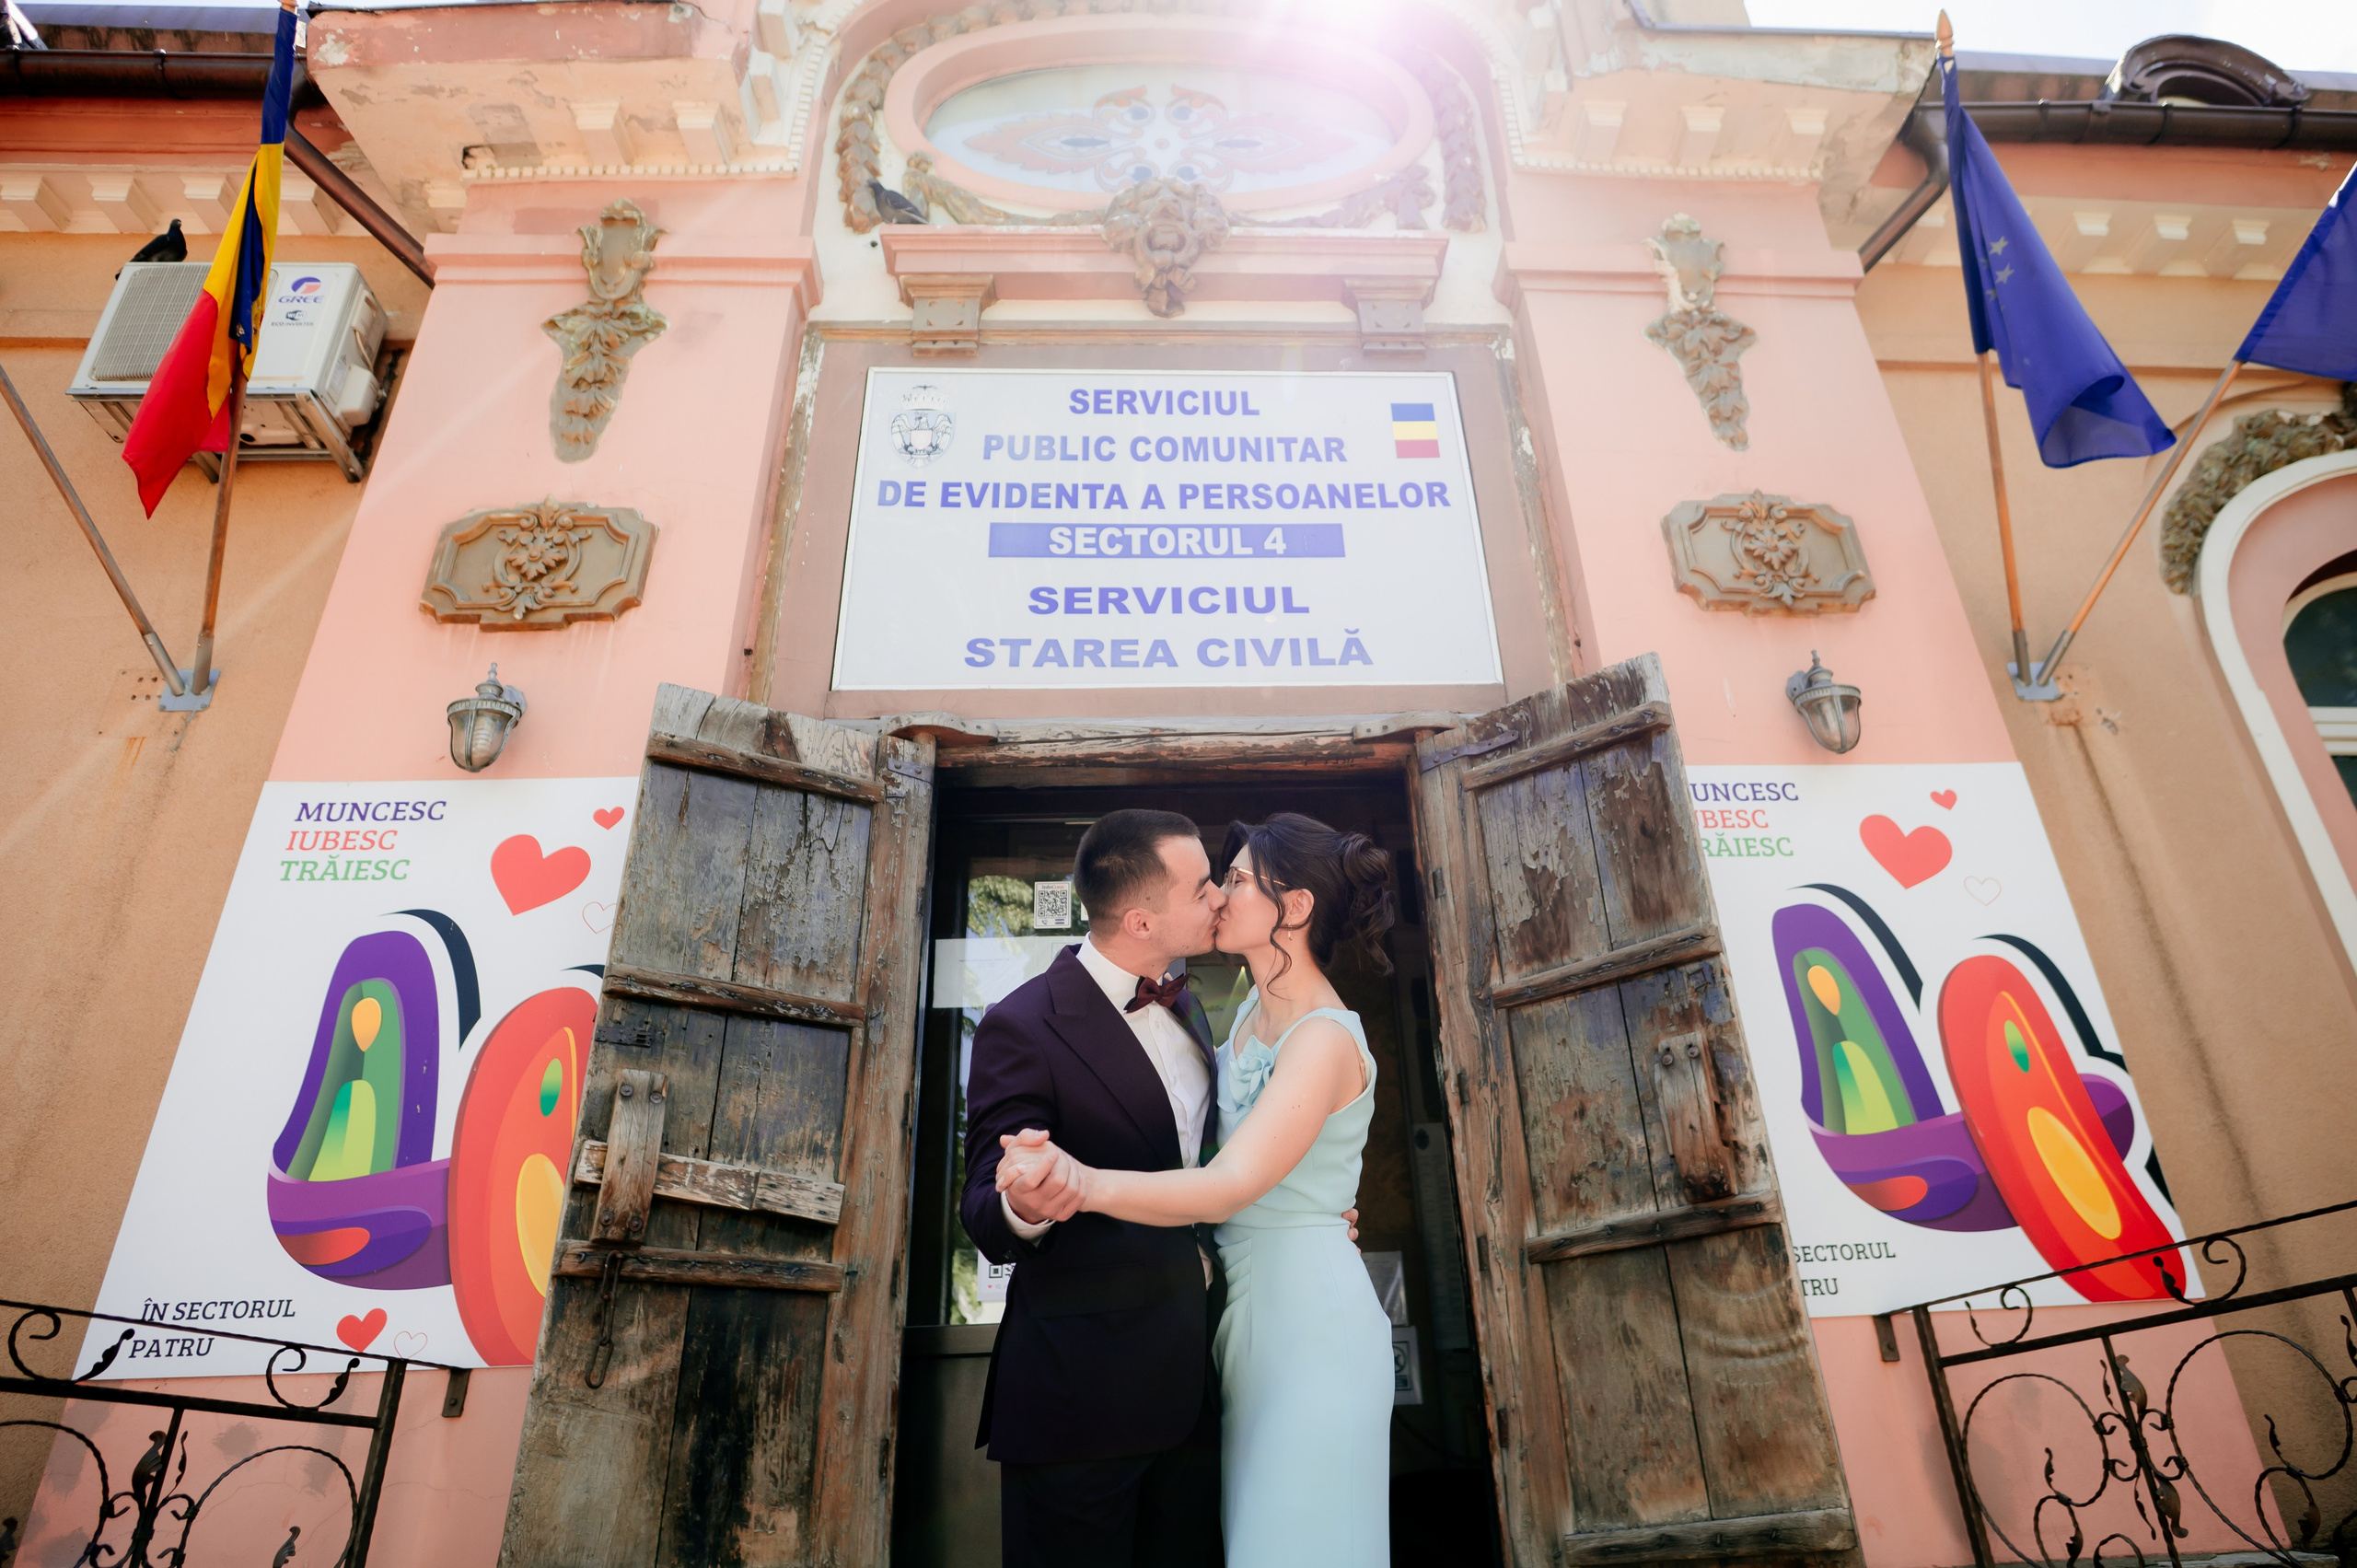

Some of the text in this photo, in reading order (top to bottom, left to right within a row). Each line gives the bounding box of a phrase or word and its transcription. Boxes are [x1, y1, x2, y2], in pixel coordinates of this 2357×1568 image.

[278, 295, 324, 304] GREE
[1068, 388, 1260, 416] SERVICIUL
[982, 434, 1348, 463] PUBLIC COMUNITAR
[877, 480, 1452, 510] DE EVIDENTA A PERSOANELOR
[1048, 526, 1287, 556] SECTORUL 4
[1028, 586, 1310, 615] SERVICIUL
[964, 628, 1375, 668] STAREA CIVILĂ
[1689, 783, 1800, 802] UNCESC
[294, 800, 447, 823] MUNCESC
[1694, 809, 1770, 830] BESC
[284, 830, 399, 852] IUBESC
[1701, 831, 1794, 857] RĂIESC
[279, 854, 411, 882] TRĂIESC
[1801, 1278, 1839, 1296] TRU
[140, 1297, 296, 1321] ÎN SECTORUL
[128, 1338, 215, 1359] PATRU
